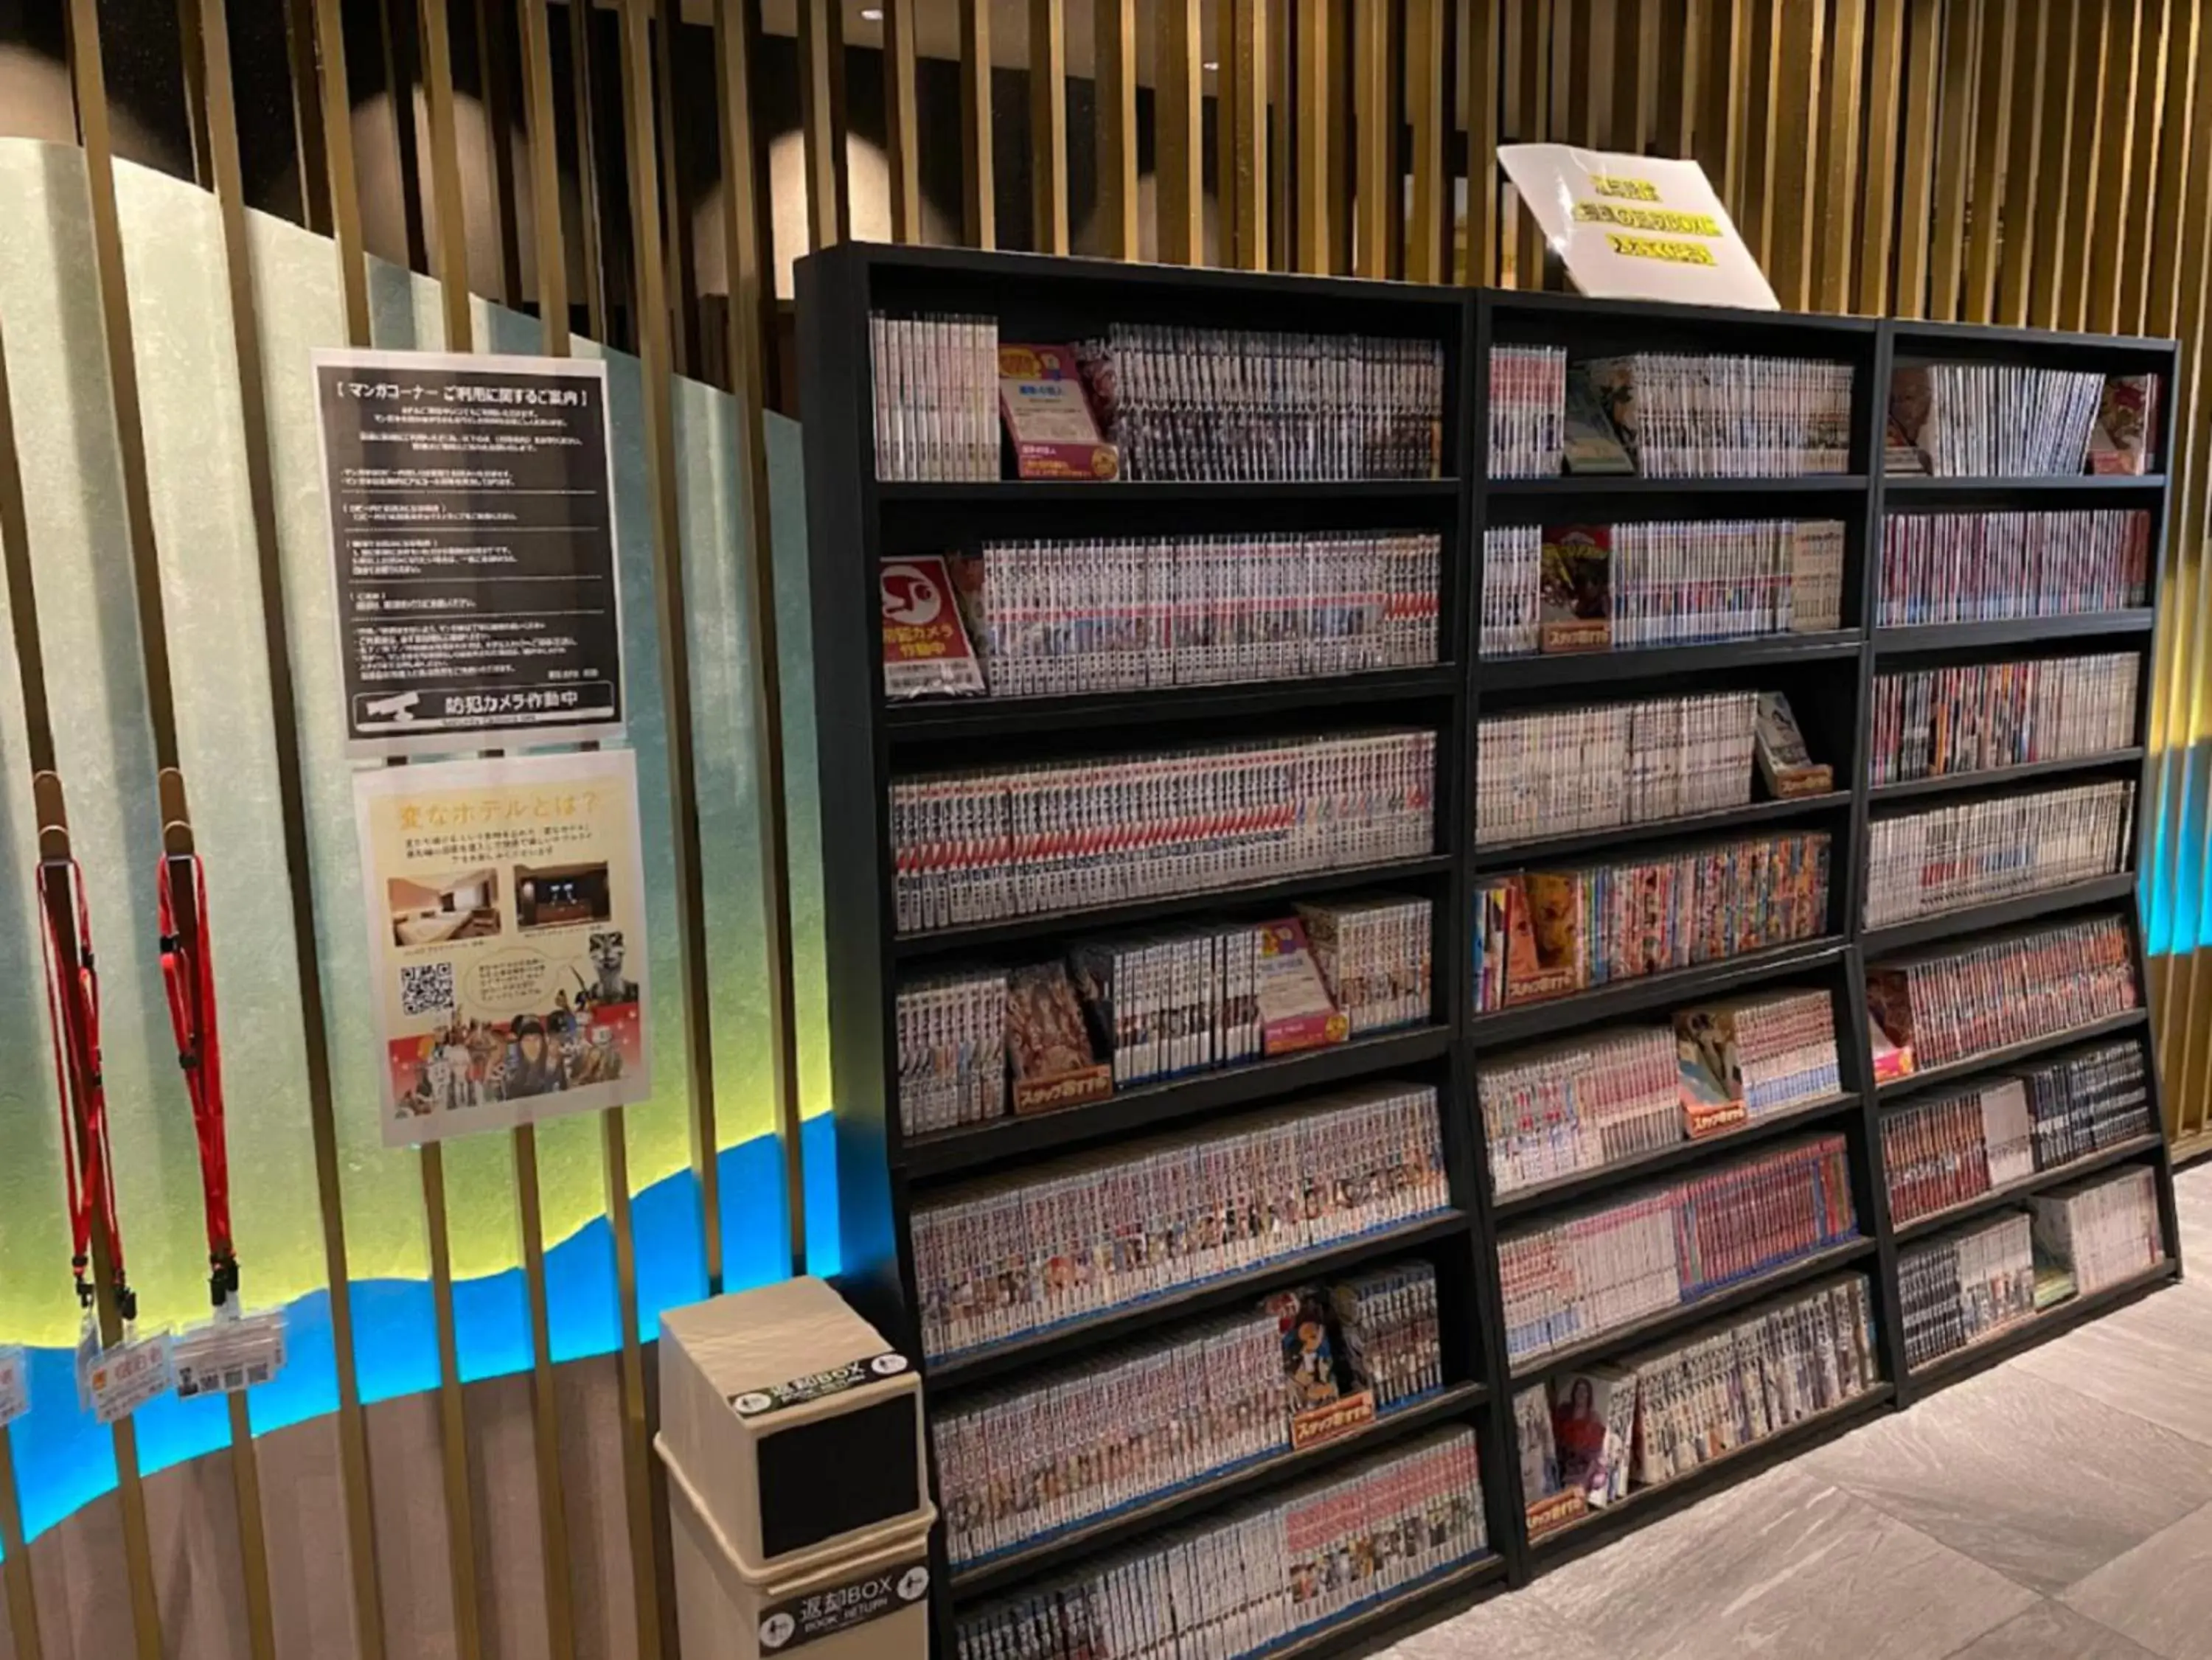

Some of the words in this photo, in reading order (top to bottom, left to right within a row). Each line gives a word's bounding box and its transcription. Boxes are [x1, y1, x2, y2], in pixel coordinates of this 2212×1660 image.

[348, 383, 438, 400] マンガコーナー
[443, 385, 577, 405] ご利用に関するご案内
[445, 691, 578, 714] 防犯カメラ作動中
[799, 1574, 893, 1622] 返却BOX
